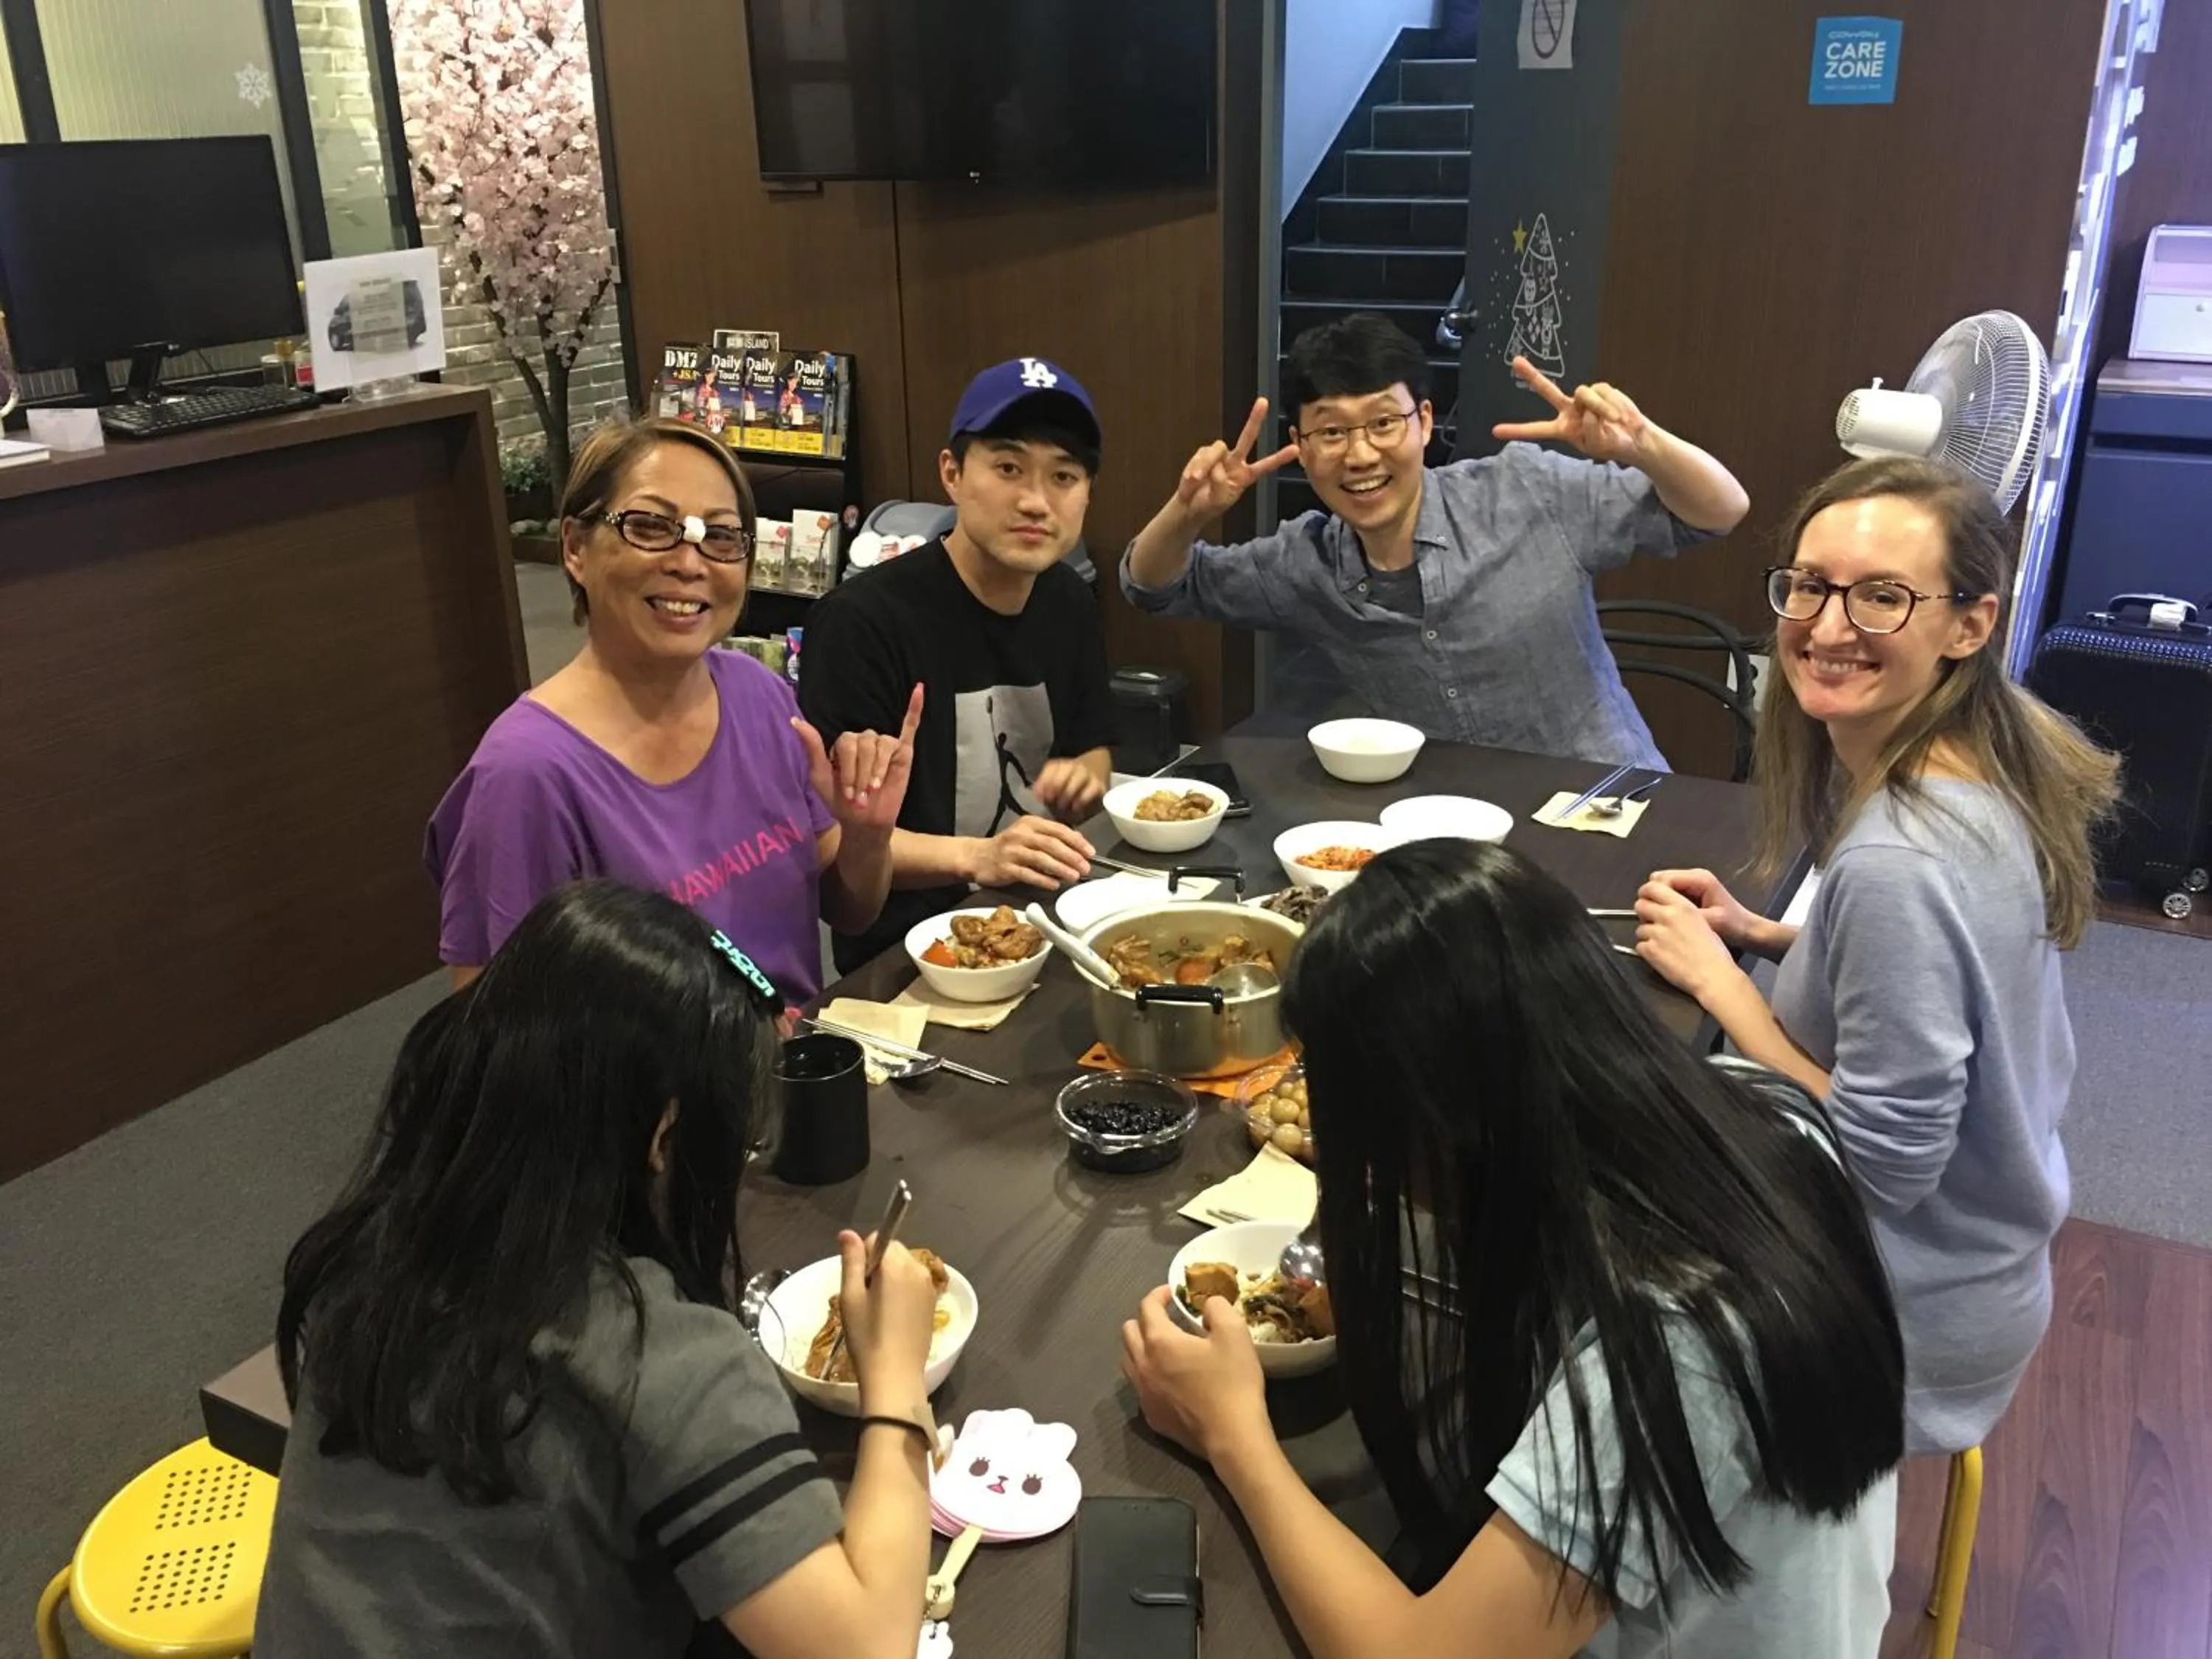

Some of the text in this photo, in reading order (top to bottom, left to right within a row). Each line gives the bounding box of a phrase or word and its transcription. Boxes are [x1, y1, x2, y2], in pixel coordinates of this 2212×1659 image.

[1826, 41, 1887, 60] CARE
[1824, 60, 1885, 79] ZONE
[712, 355, 741, 372] Daily
[746, 357, 775, 374] Daily
[794, 359, 825, 378] Daily
[718, 370, 740, 380] Tours
[753, 372, 775, 383] Tours
[802, 375, 824, 386] Tours
[1018, 358, 1057, 389] LA
